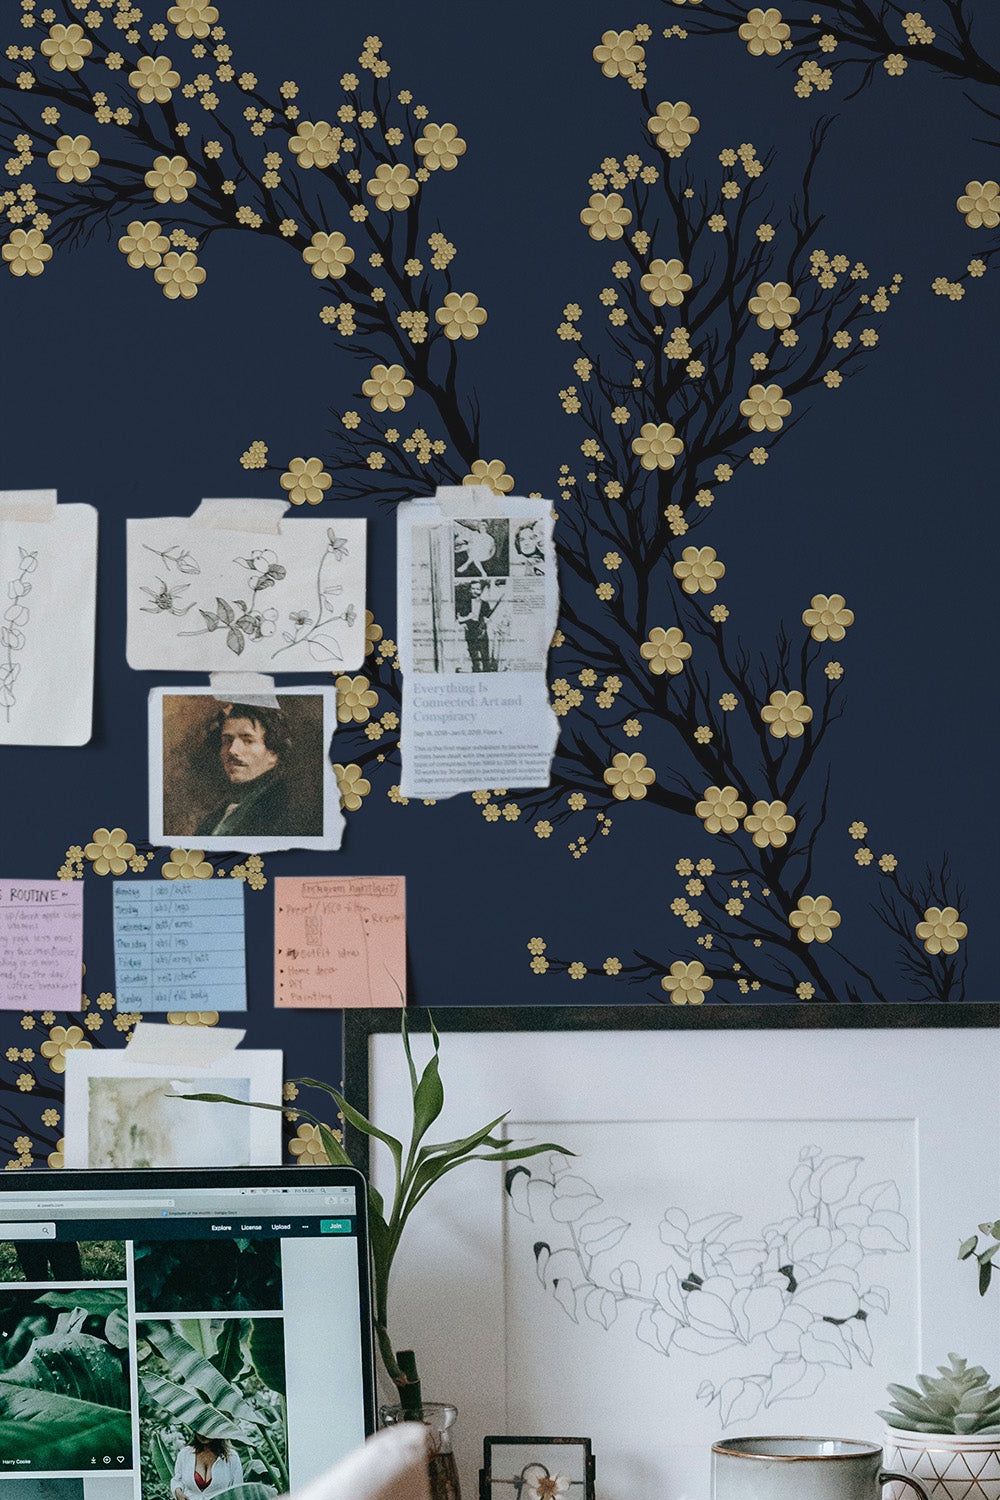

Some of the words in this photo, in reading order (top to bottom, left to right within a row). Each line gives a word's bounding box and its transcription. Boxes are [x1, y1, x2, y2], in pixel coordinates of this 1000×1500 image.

[413, 682, 476, 696] Everything
[478, 682, 489, 693] Is
[413, 697, 477, 708] Connected:
[480, 696, 499, 706] Art
[501, 695, 522, 706] and
[413, 711, 477, 724] Conspiracy
[10, 888, 60, 903] ROUTINE
[211, 1224, 232, 1232] Explore
[271, 1223, 291, 1231] Upload
